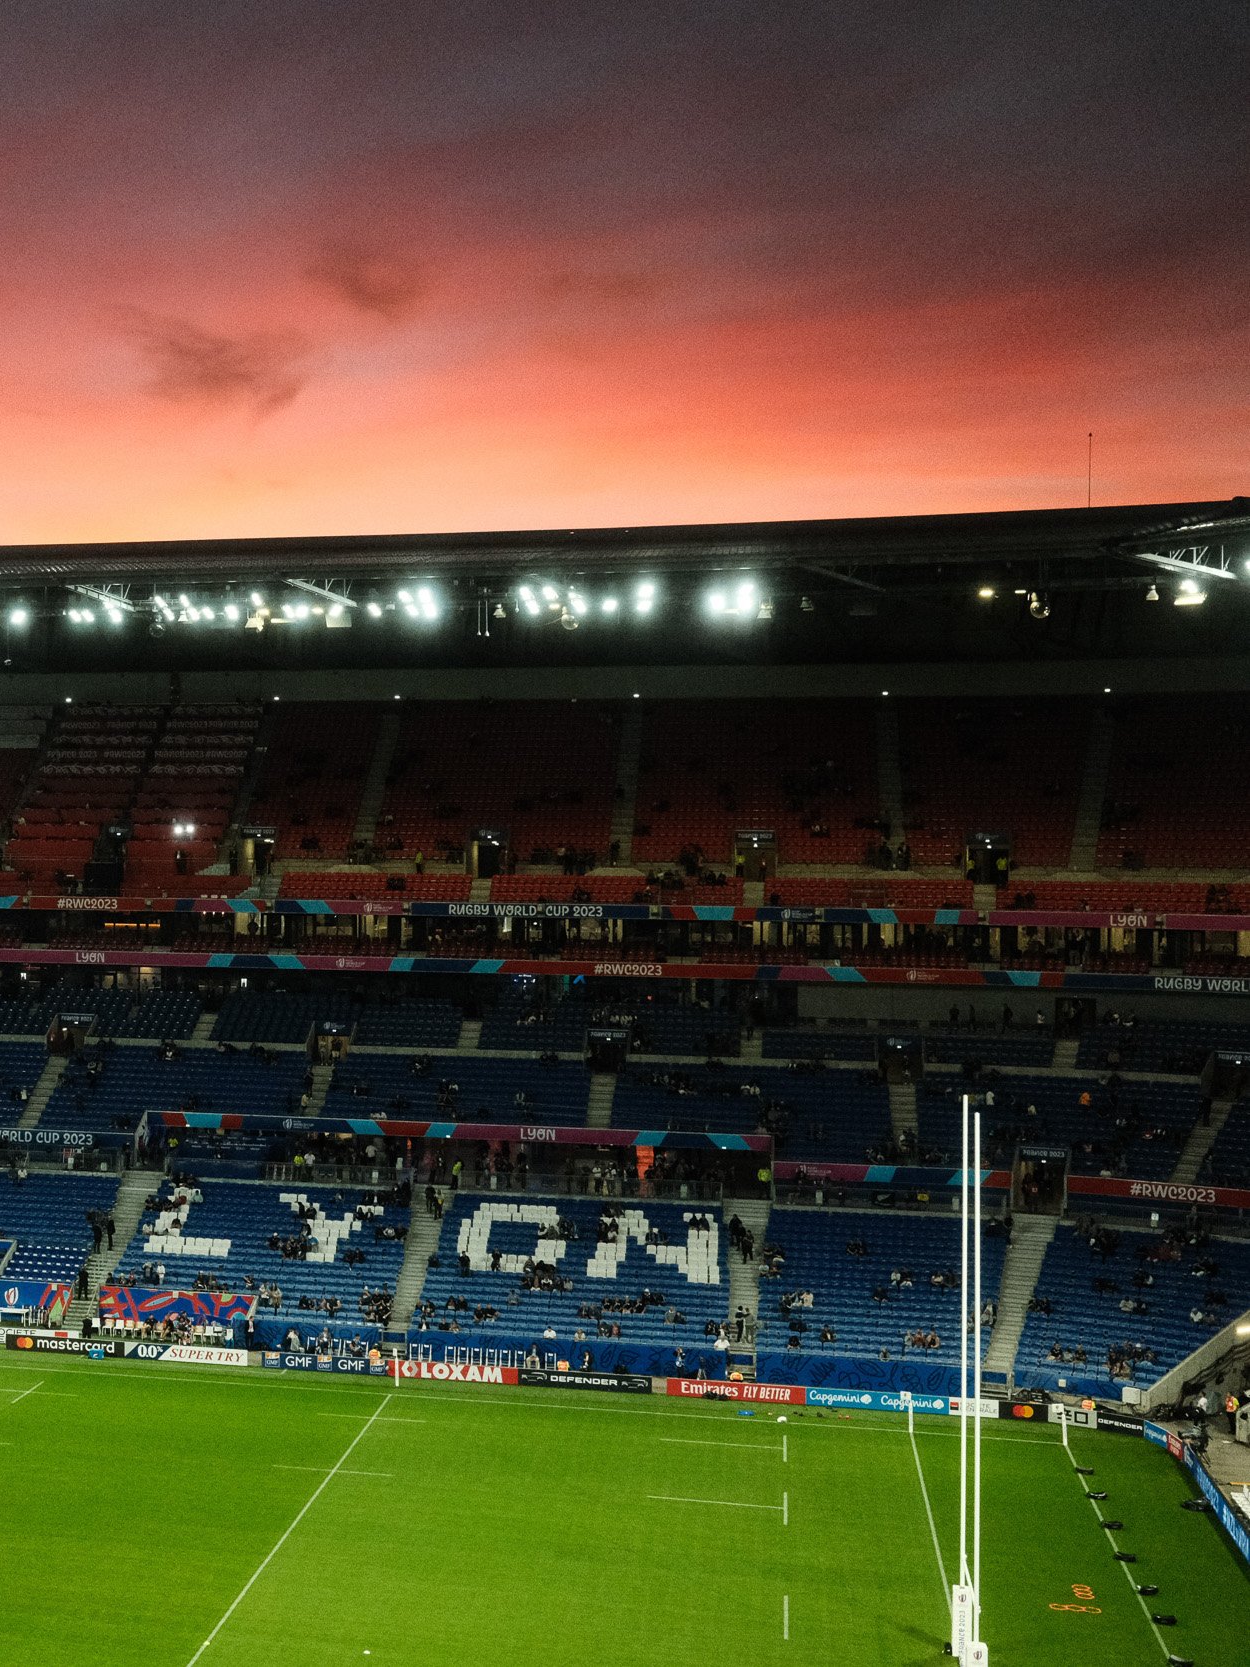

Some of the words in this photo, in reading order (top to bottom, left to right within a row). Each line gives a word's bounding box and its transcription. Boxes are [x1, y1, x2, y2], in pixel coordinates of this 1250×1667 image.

[57, 897, 118, 910] #RWC2023
[449, 904, 491, 916] RUGBY
[493, 904, 538, 917] WORLD
[545, 905, 570, 917] CUP
[573, 905, 603, 918] 2023
[1110, 913, 1147, 927] LYON
[76, 951, 105, 963] LYON
[593, 963, 662, 977] #RWC2023
[1154, 977, 1203, 991] RUGBY
[35, 1132, 60, 1143] CUP
[62, 1133, 93, 1146] 2023
[520, 1127, 556, 1141] LYON
[1130, 1182, 1216, 1203] #RWC2023
[37, 1338, 115, 1353] mastercard
[170, 1348, 214, 1362] SUPER
[217, 1351, 244, 1363] TRY
[285, 1355, 312, 1367] GMF
[338, 1359, 364, 1371] GMF
[421, 1365, 503, 1383] LOXAM
[550, 1375, 618, 1386] DEFENDER
[681, 1381, 738, 1397] Emirates
[743, 1386, 758, 1398] FLY
[759, 1387, 791, 1401] BETTER
[809, 1390, 860, 1405] Capgemini
[1097, 1418, 1143, 1430] DEFENDER
